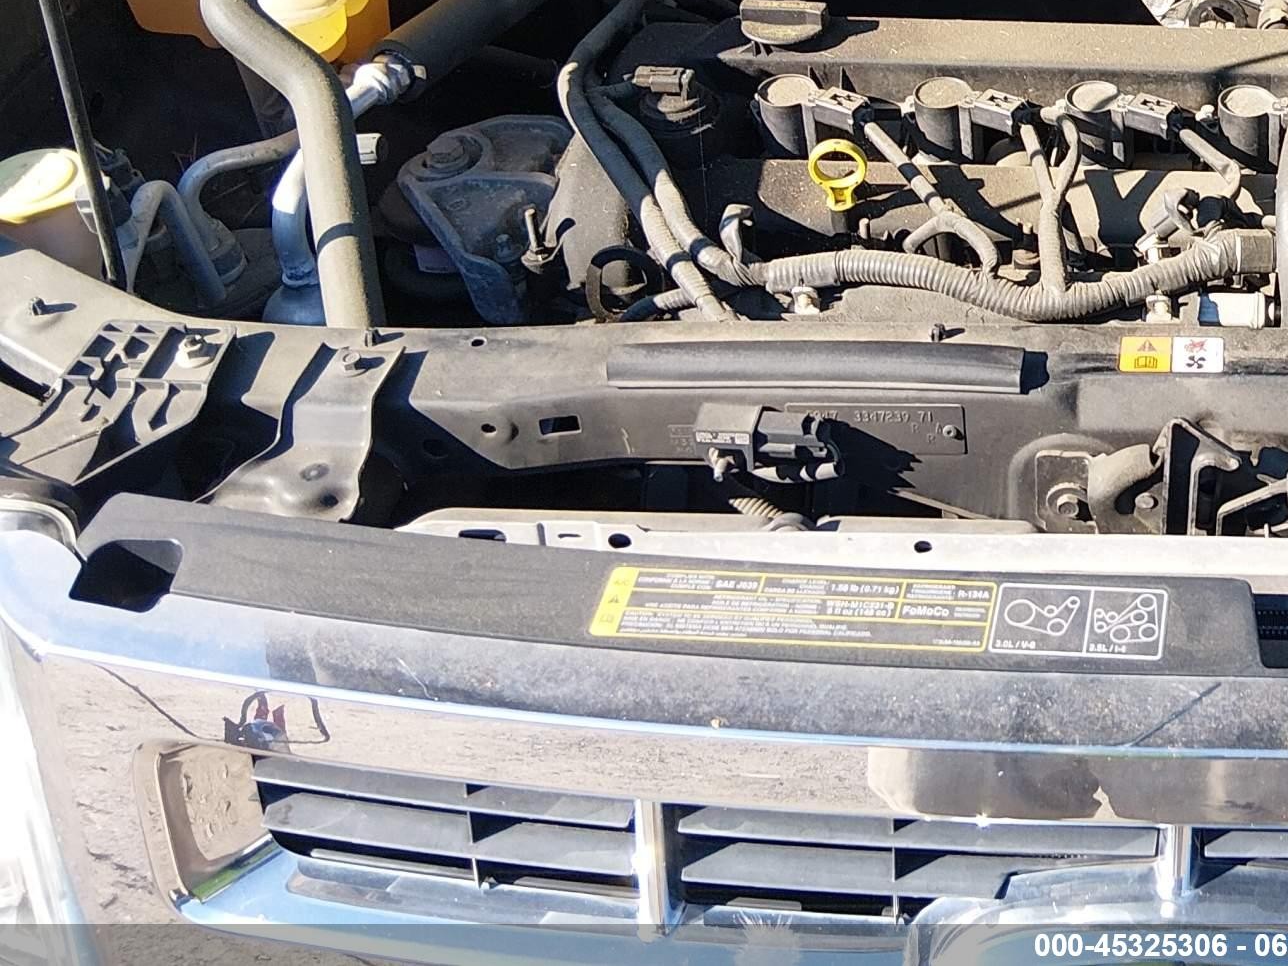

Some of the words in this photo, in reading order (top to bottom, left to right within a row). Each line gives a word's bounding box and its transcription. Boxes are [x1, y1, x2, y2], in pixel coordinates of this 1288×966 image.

[714, 579, 735, 589] SAE
[736, 580, 758, 590] J639
[957, 589, 990, 599] R-134A
[901, 604, 950, 617] FoMoCo
[995, 639, 1014, 648] 3.0L
